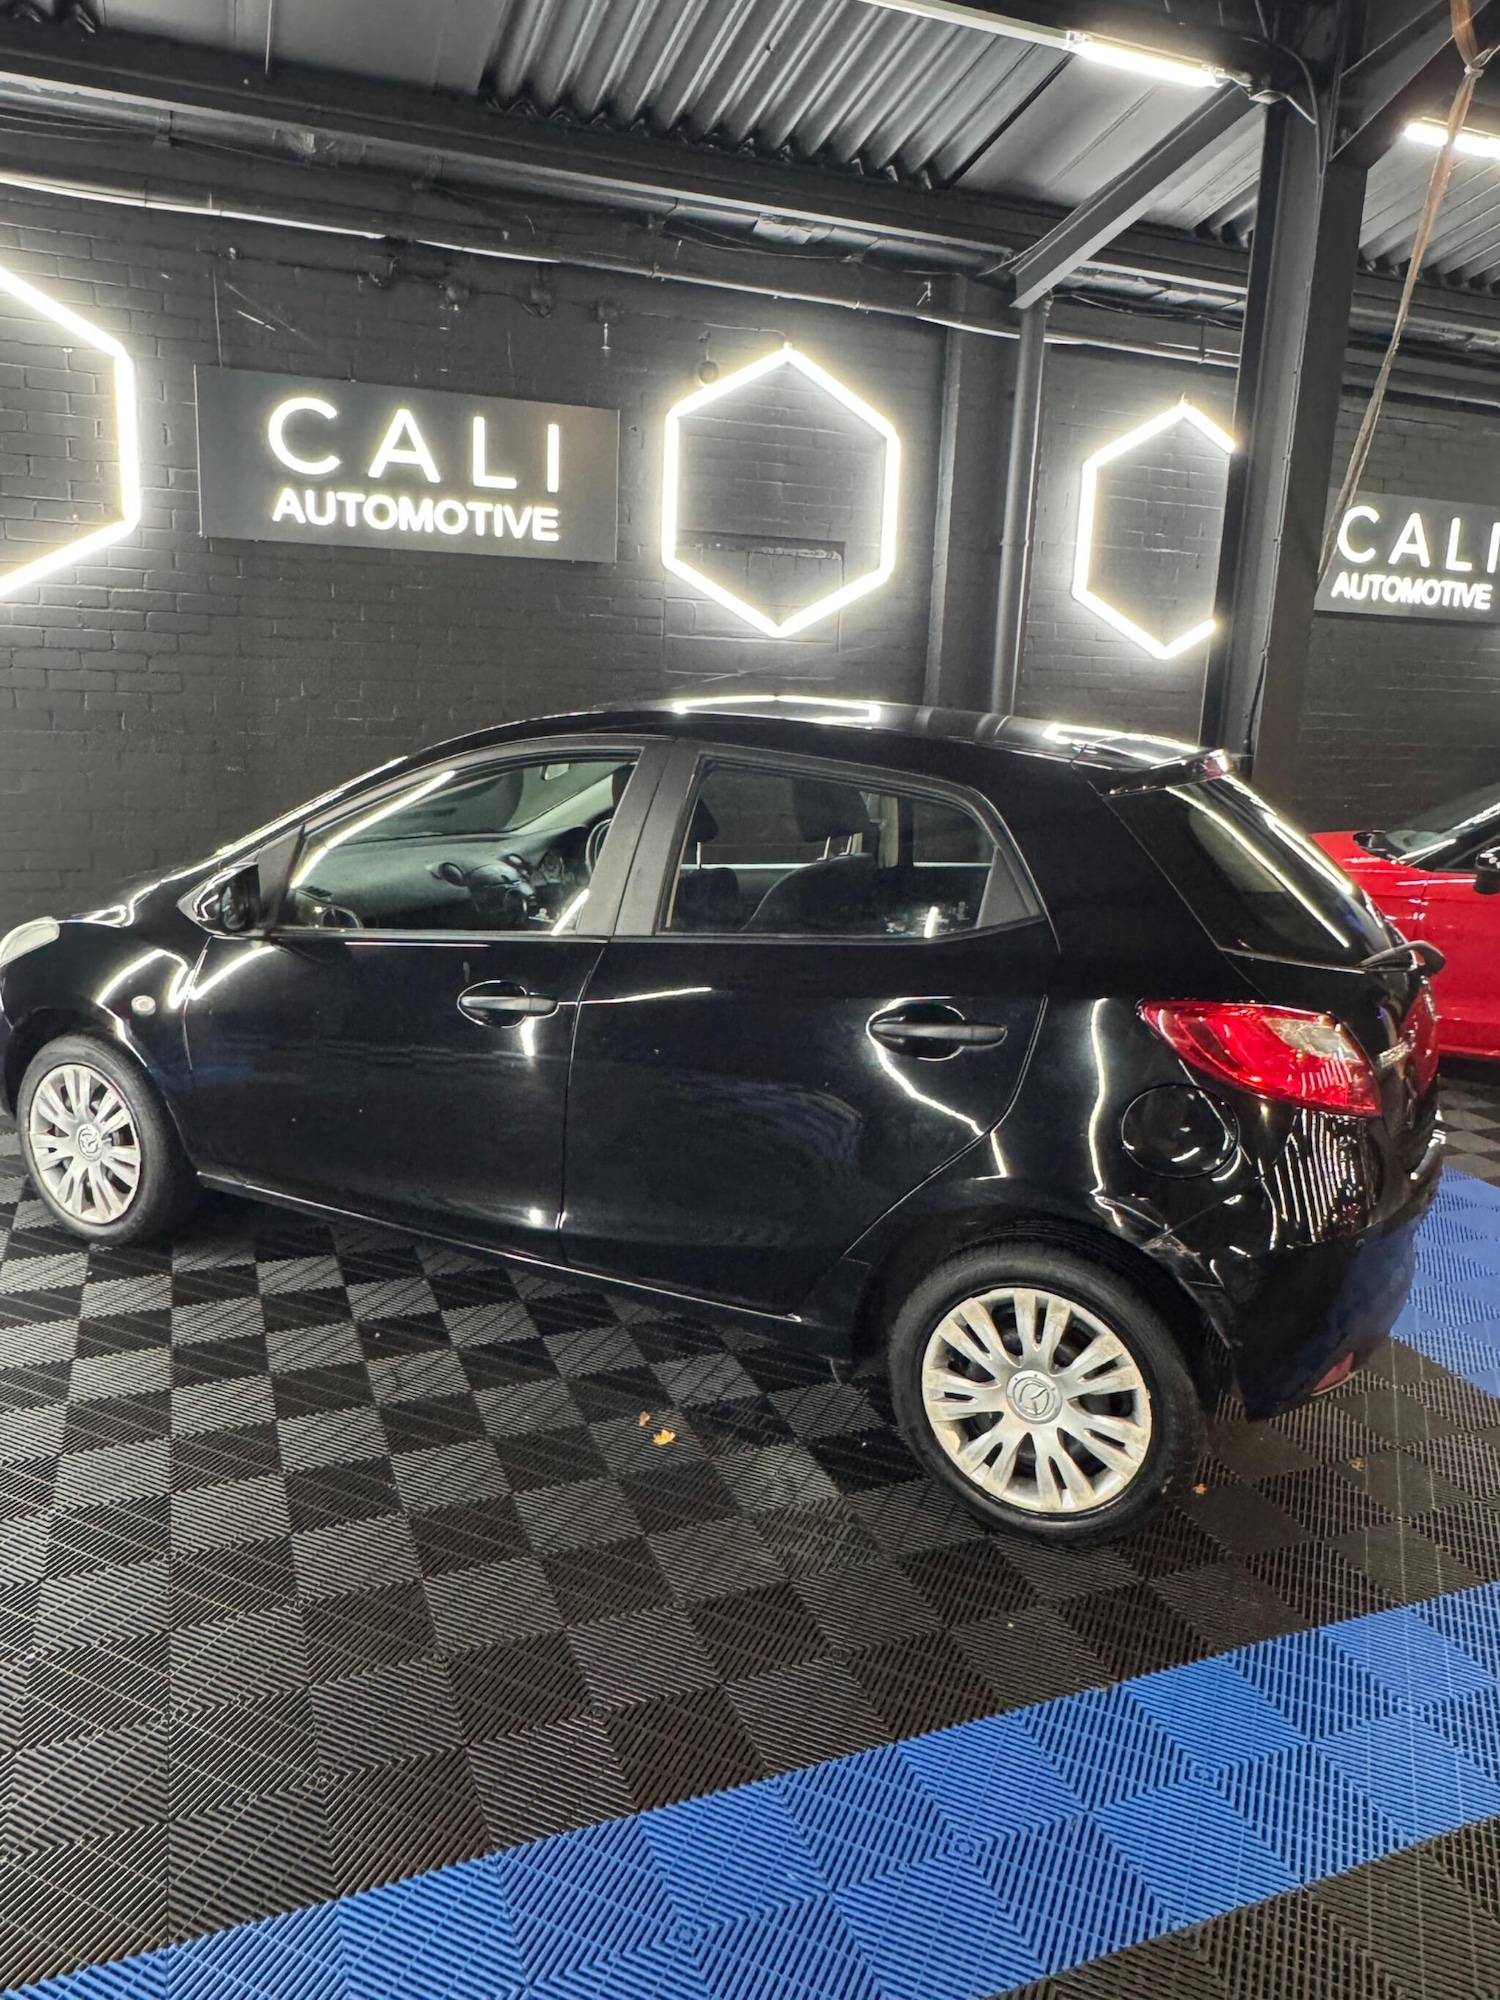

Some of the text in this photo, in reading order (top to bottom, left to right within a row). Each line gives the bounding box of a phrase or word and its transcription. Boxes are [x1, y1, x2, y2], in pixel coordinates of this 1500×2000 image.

[268, 397, 560, 493] CALI
[272, 487, 560, 541] AUTOMOTIVE
[1337, 505, 1500, 574] CALI
[1331, 571, 1493, 610] AUTOMOTIVE
